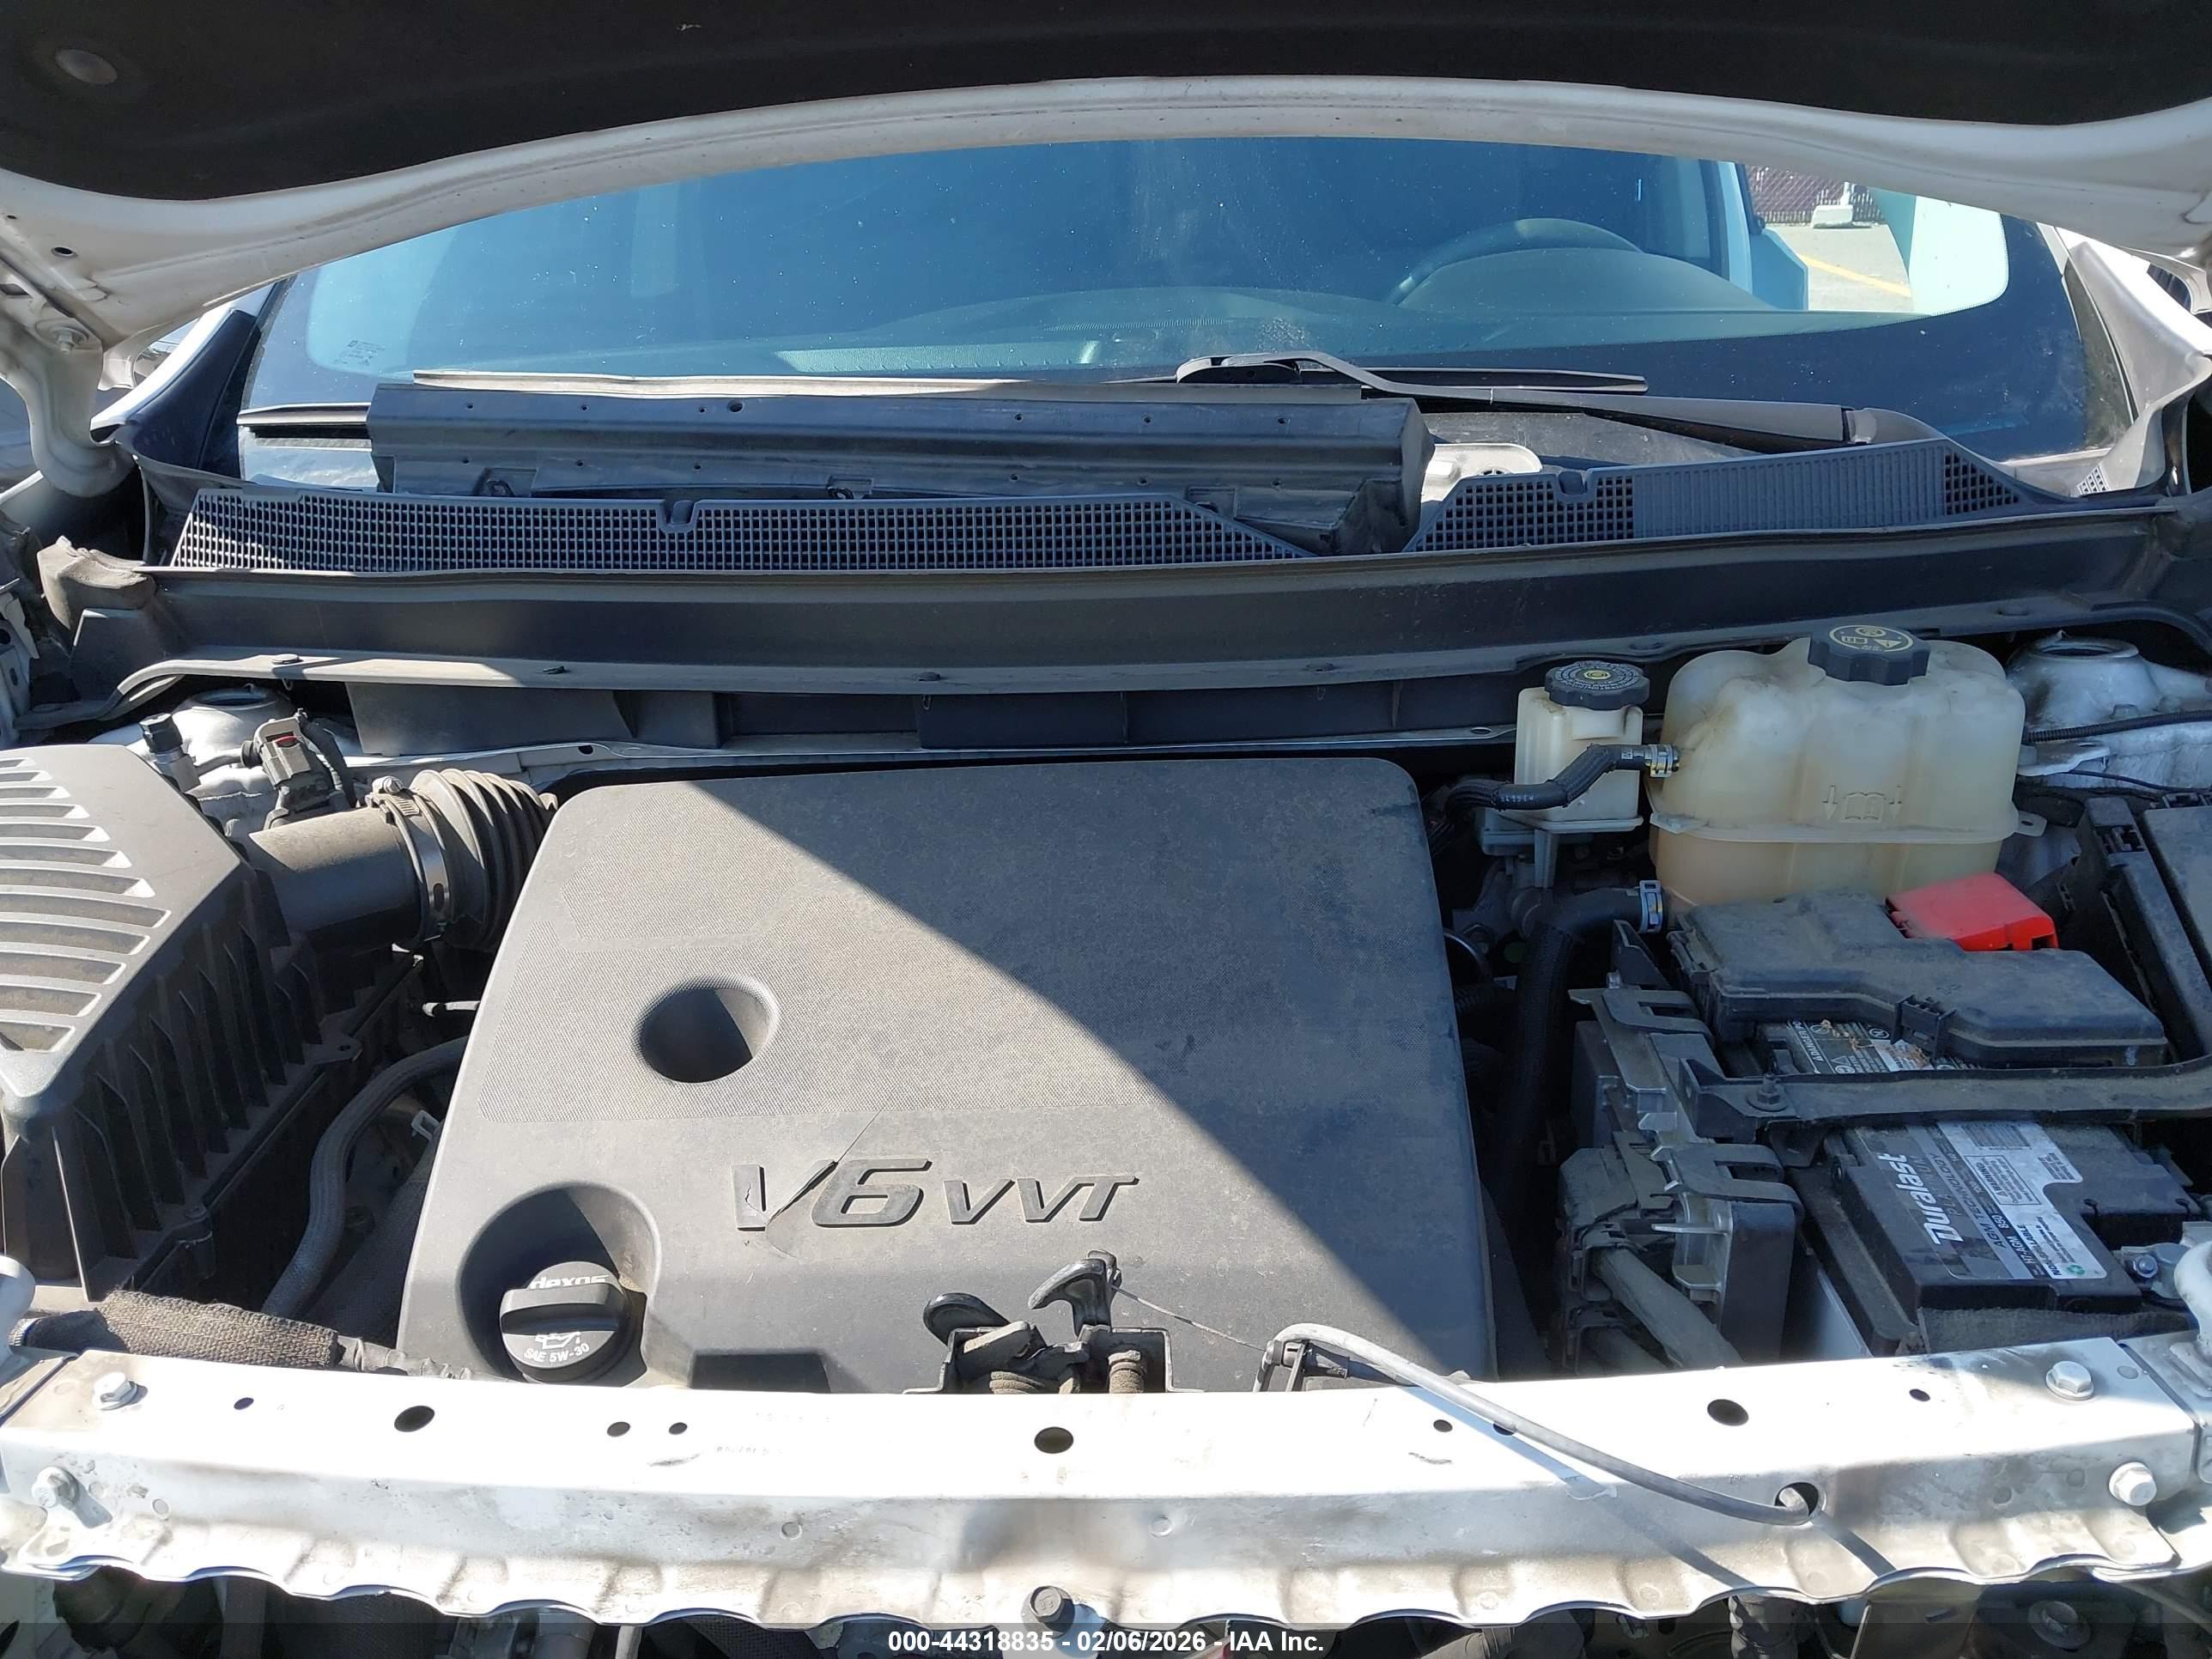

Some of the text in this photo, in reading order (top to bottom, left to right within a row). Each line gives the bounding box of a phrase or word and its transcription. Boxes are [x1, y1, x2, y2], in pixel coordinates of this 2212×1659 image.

[1798, 1030, 1820, 1056] DANGER
[731, 1158, 1140, 1231] V6 VVT
[1876, 1152, 1965, 1245] Duralast
[1929, 1153, 1985, 1220] TECHNOLOGY
[1991, 1214, 2009, 1229] 850
[1979, 1223, 2007, 1249] AGM
[2006, 1236, 2036, 1264] H7-AGM
[2017, 1224, 2062, 1276] NON-SPILLABLE
[524, 1342, 590, 1363] SAE 5W-30
